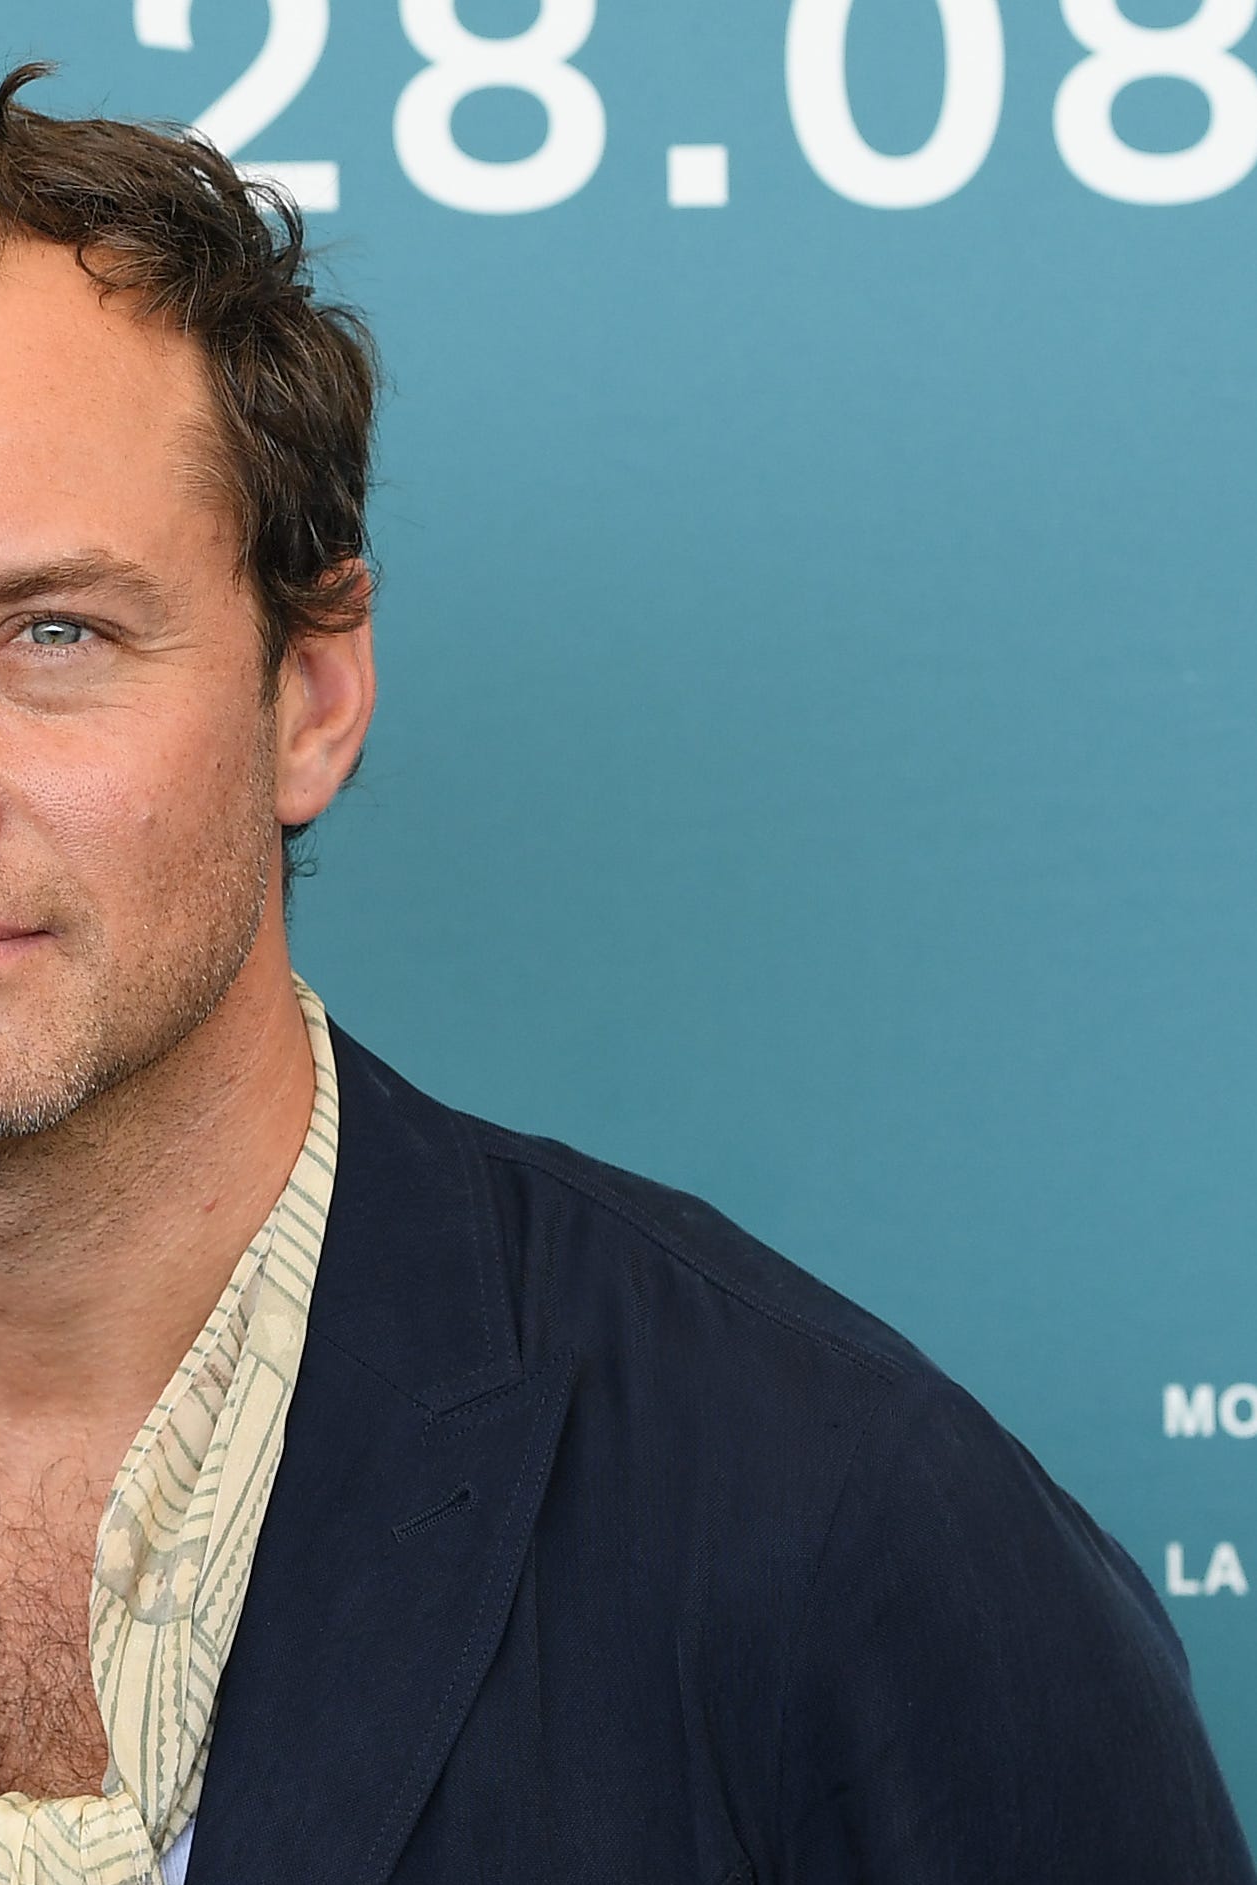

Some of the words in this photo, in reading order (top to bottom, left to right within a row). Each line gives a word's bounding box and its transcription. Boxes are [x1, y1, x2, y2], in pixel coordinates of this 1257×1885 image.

[134, 0, 1257, 215] 28.08
[1163, 1382, 1257, 1439] MO
[1165, 1541, 1249, 1596] LA
